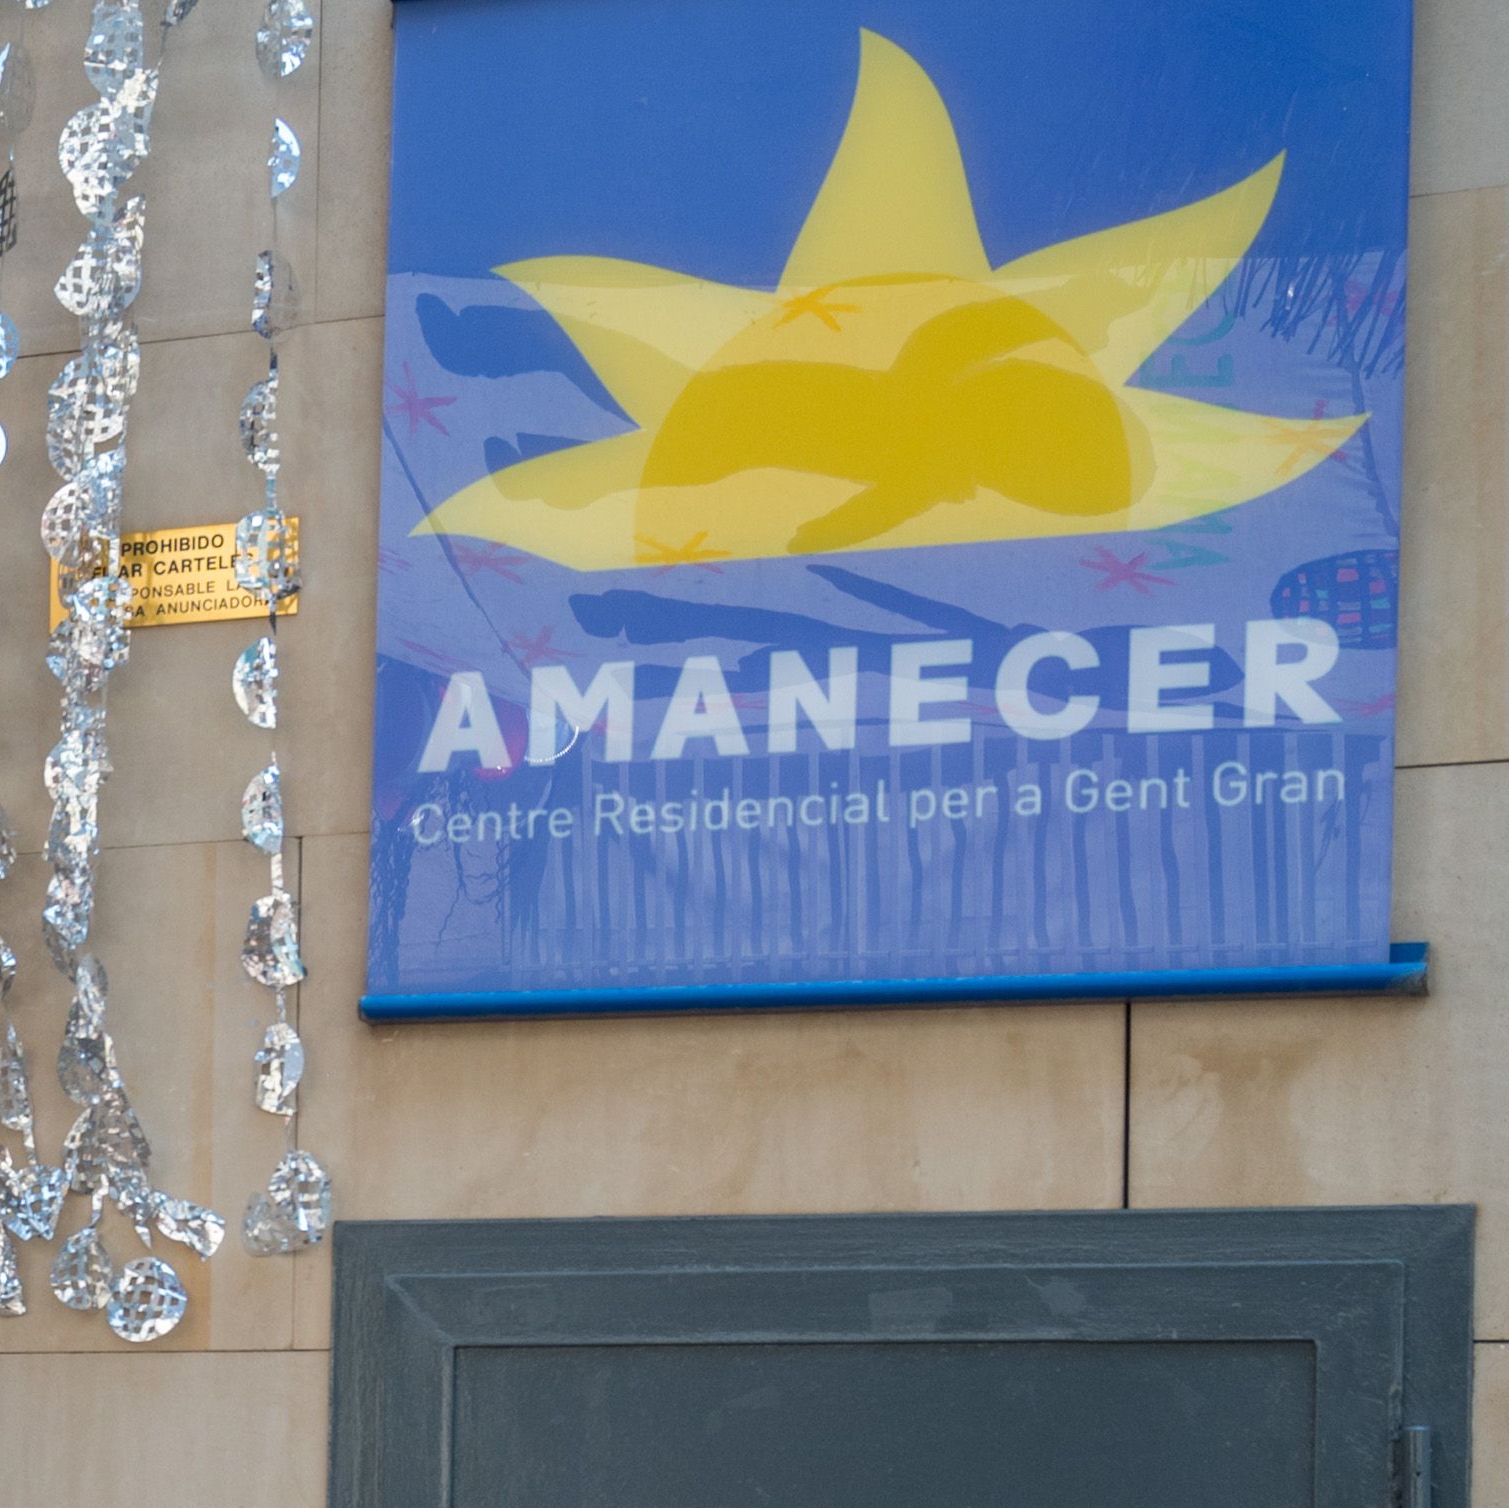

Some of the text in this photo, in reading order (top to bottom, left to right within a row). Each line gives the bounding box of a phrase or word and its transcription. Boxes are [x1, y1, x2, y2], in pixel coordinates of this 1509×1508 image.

[121, 533, 225, 557] PROHIBIDO
[417, 618, 1343, 773] AMANECER
[412, 760, 1347, 844] Centre Residencial per a Gent Gran
